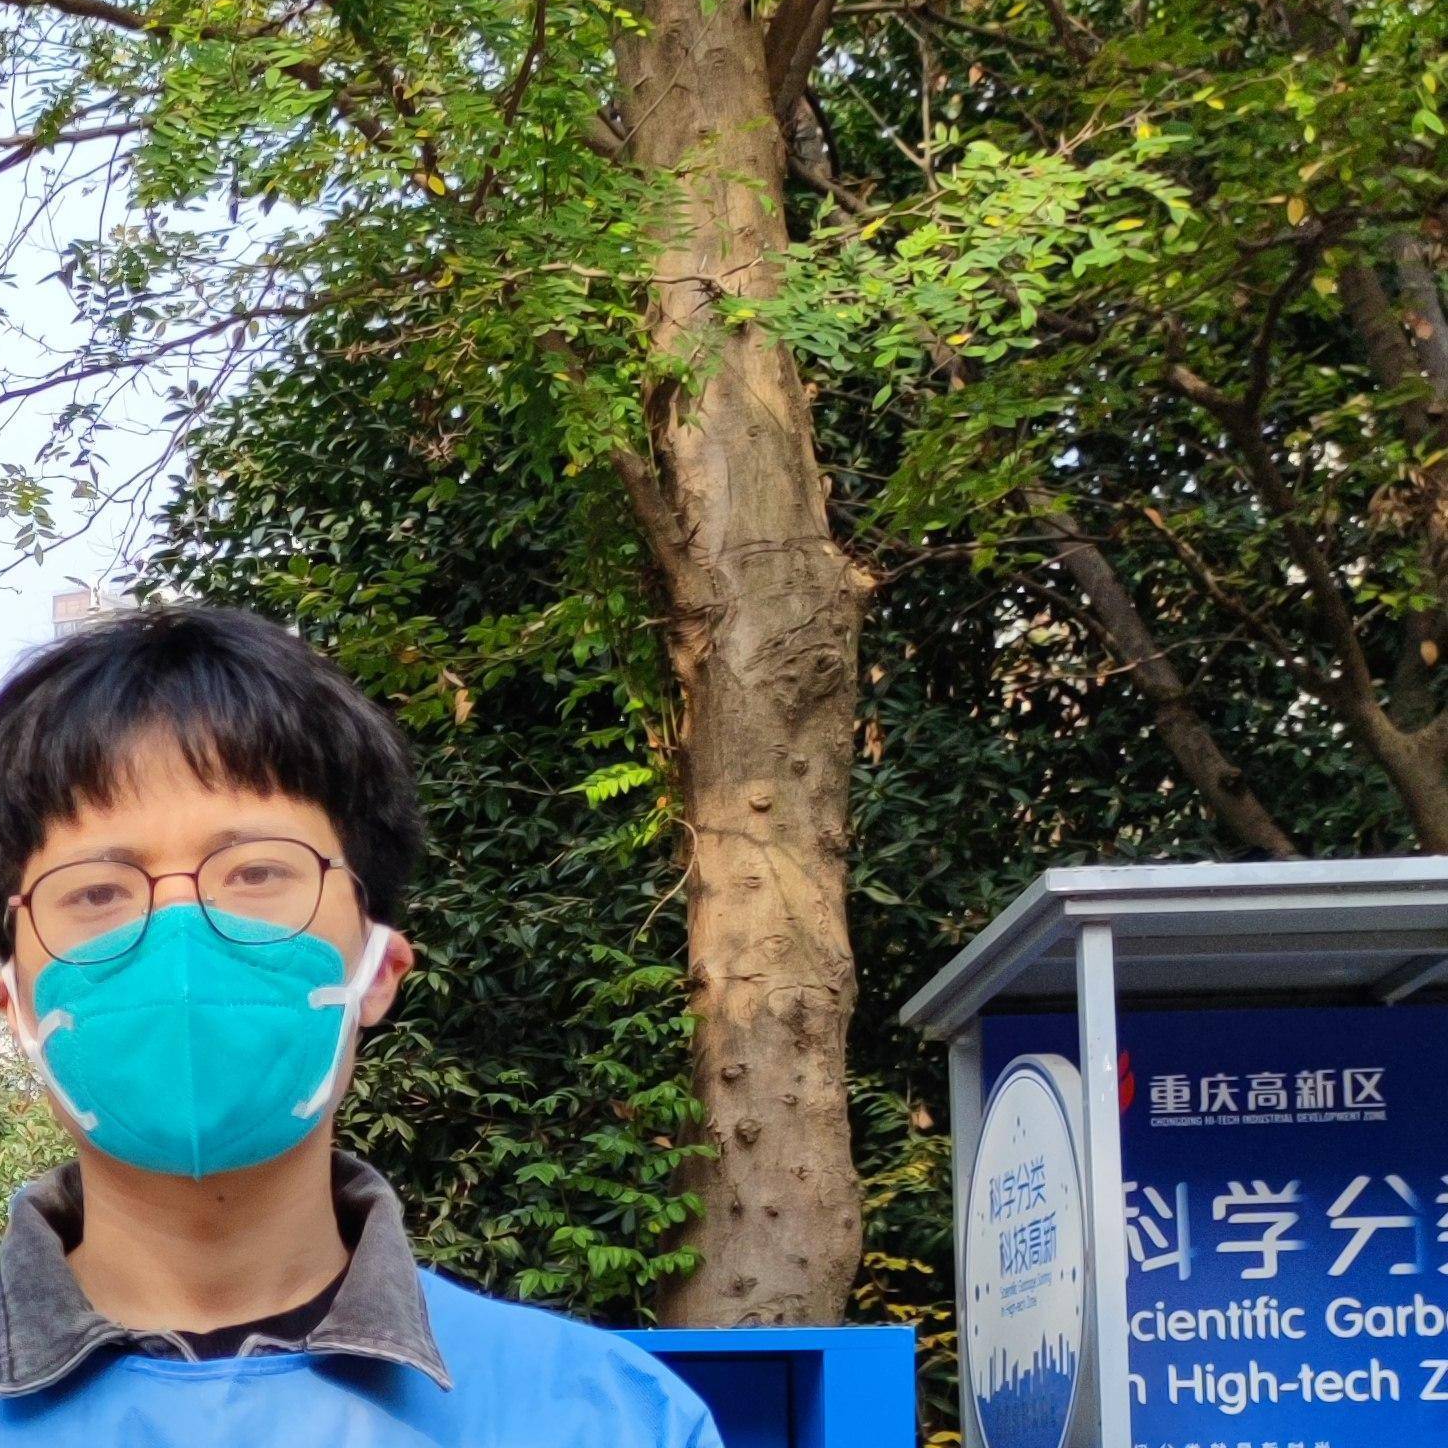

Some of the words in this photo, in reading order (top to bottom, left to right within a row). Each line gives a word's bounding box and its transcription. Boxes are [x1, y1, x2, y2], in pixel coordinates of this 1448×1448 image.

[1149, 1067, 1386, 1114] 重庆高新区
[1125, 1296, 1306, 1342] cientific
[1325, 1294, 1448, 1339] Garb
[1168, 1357, 1400, 1415] High-tech
